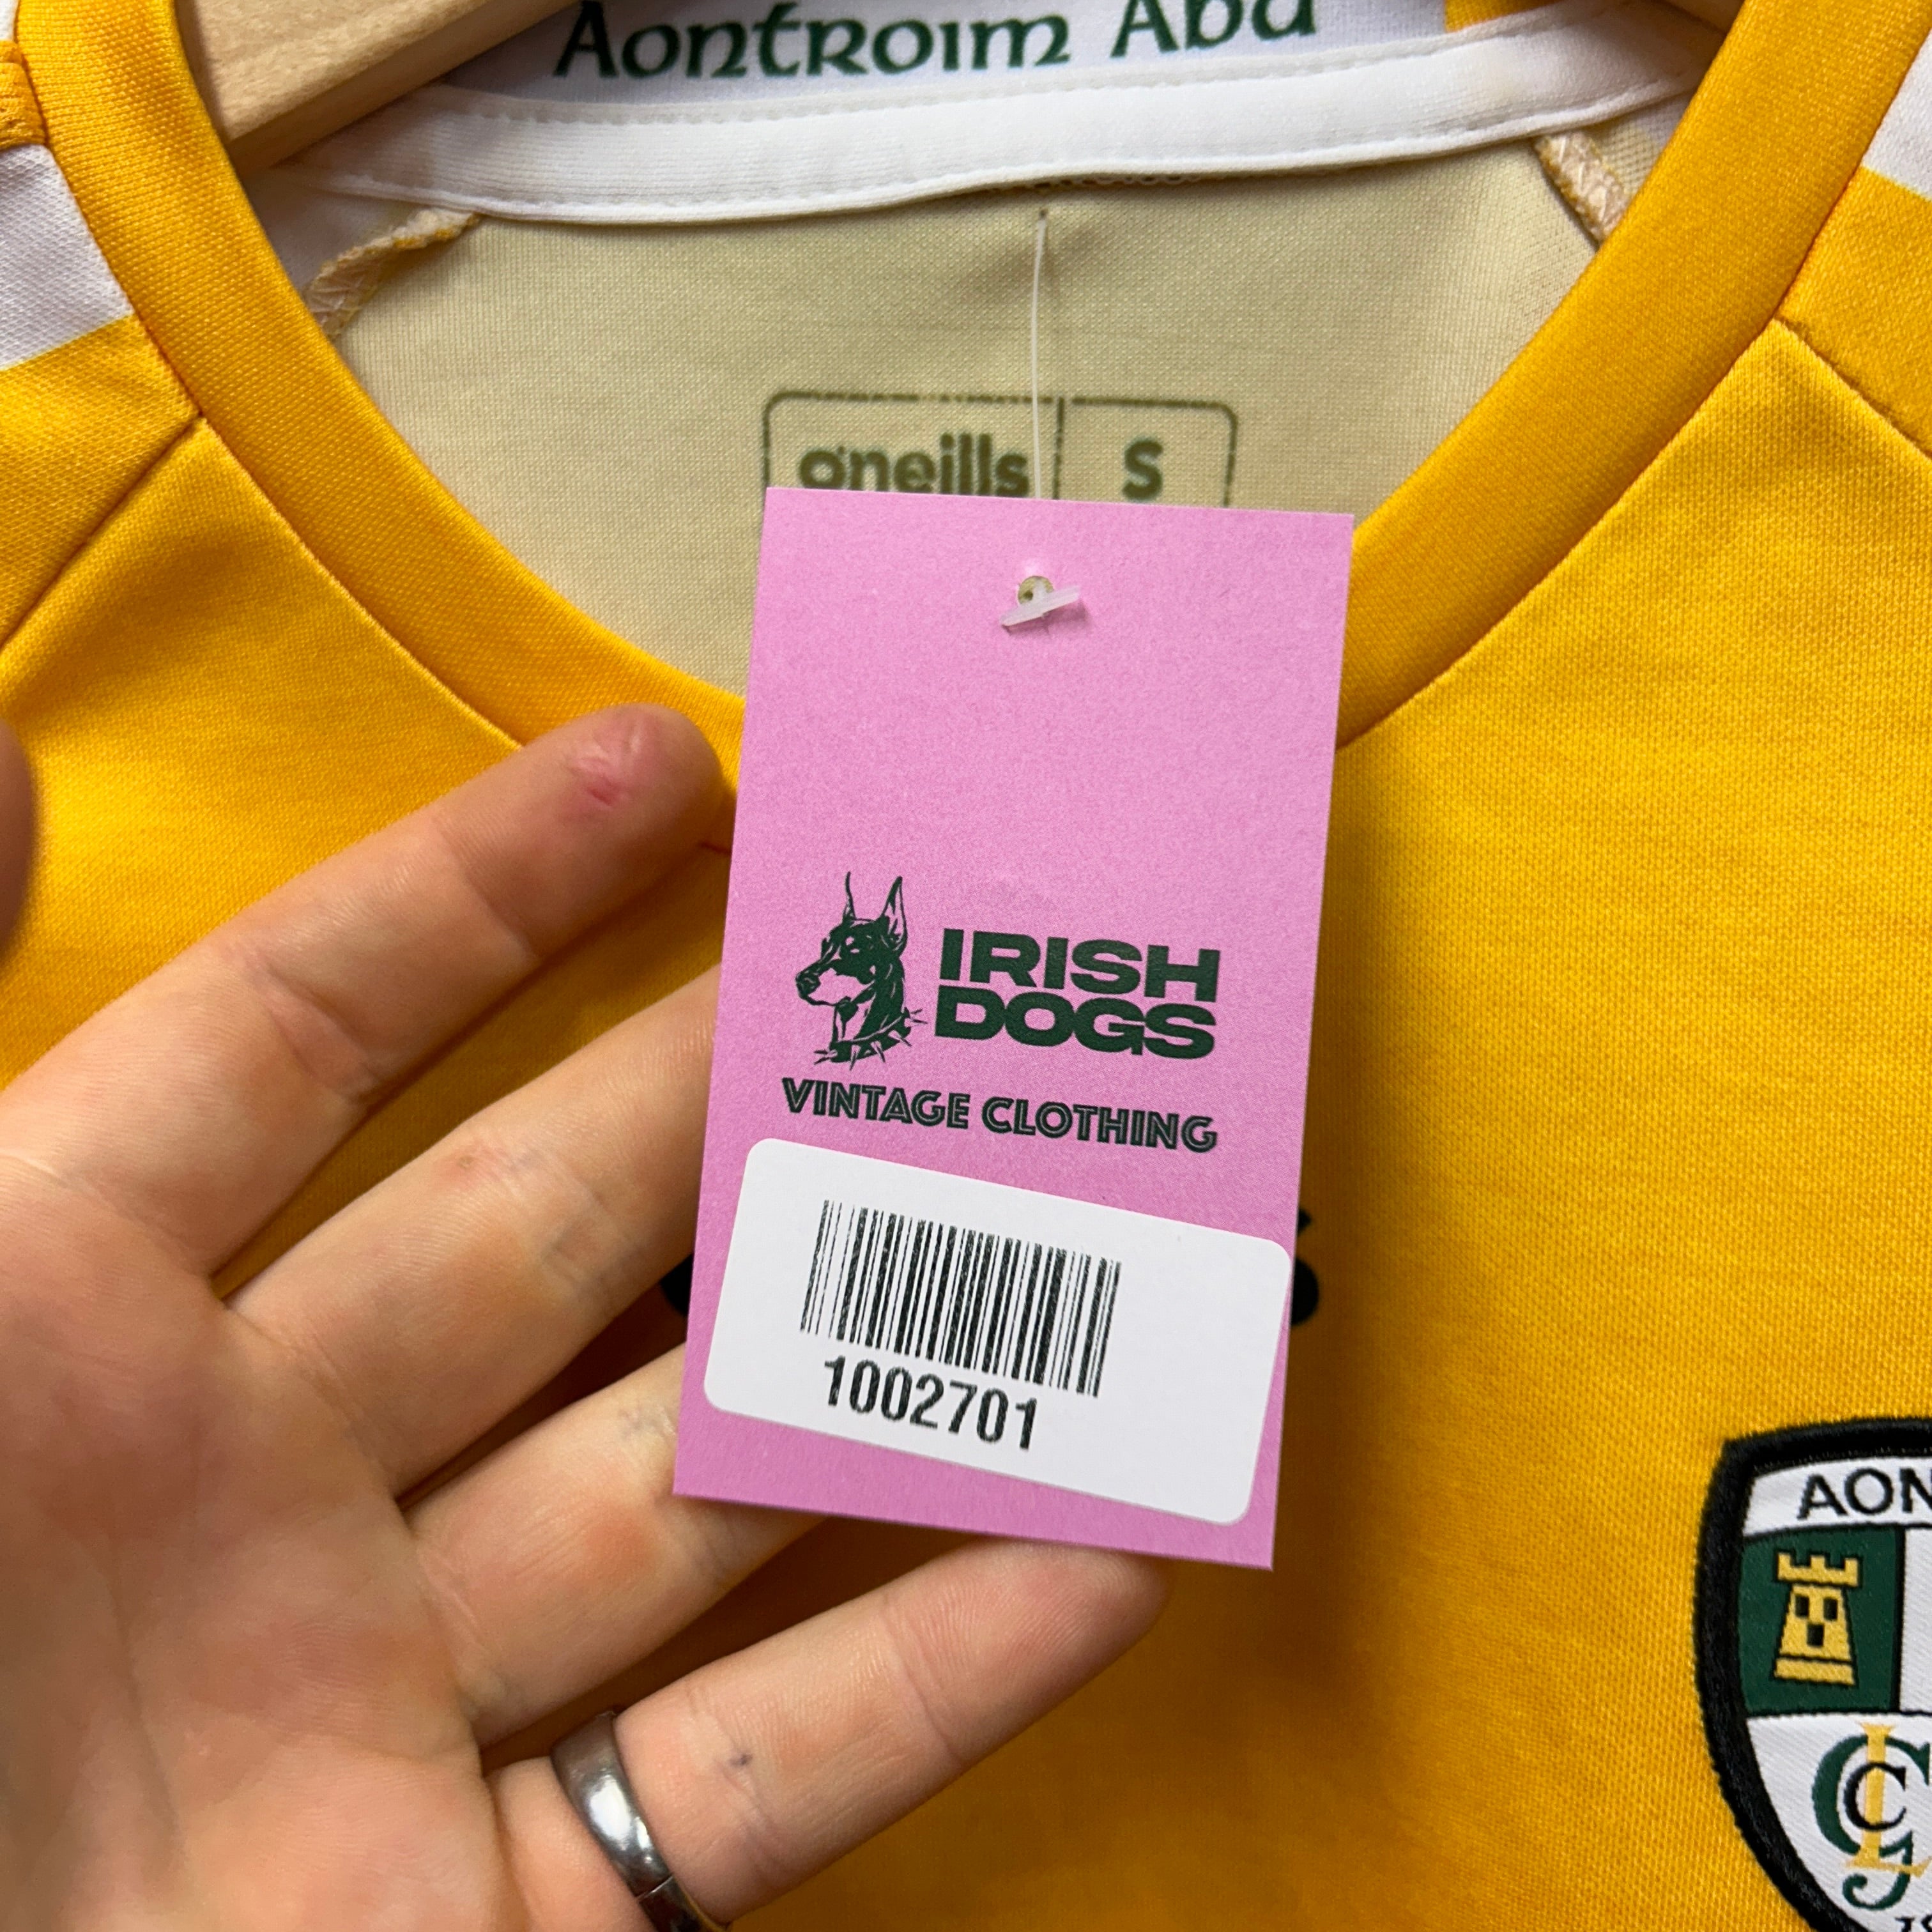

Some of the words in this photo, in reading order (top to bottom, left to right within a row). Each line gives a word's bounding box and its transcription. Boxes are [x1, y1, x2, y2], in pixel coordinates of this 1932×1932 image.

[1121, 436, 1164, 502] S
[939, 928, 1221, 1003] IRISH
[934, 985, 1216, 1060] DOGS
[781, 1077, 971, 1130] VINTAGE
[981, 1096, 1218, 1154] CLOTHING
[824, 1354, 1037, 1450] 1002701
